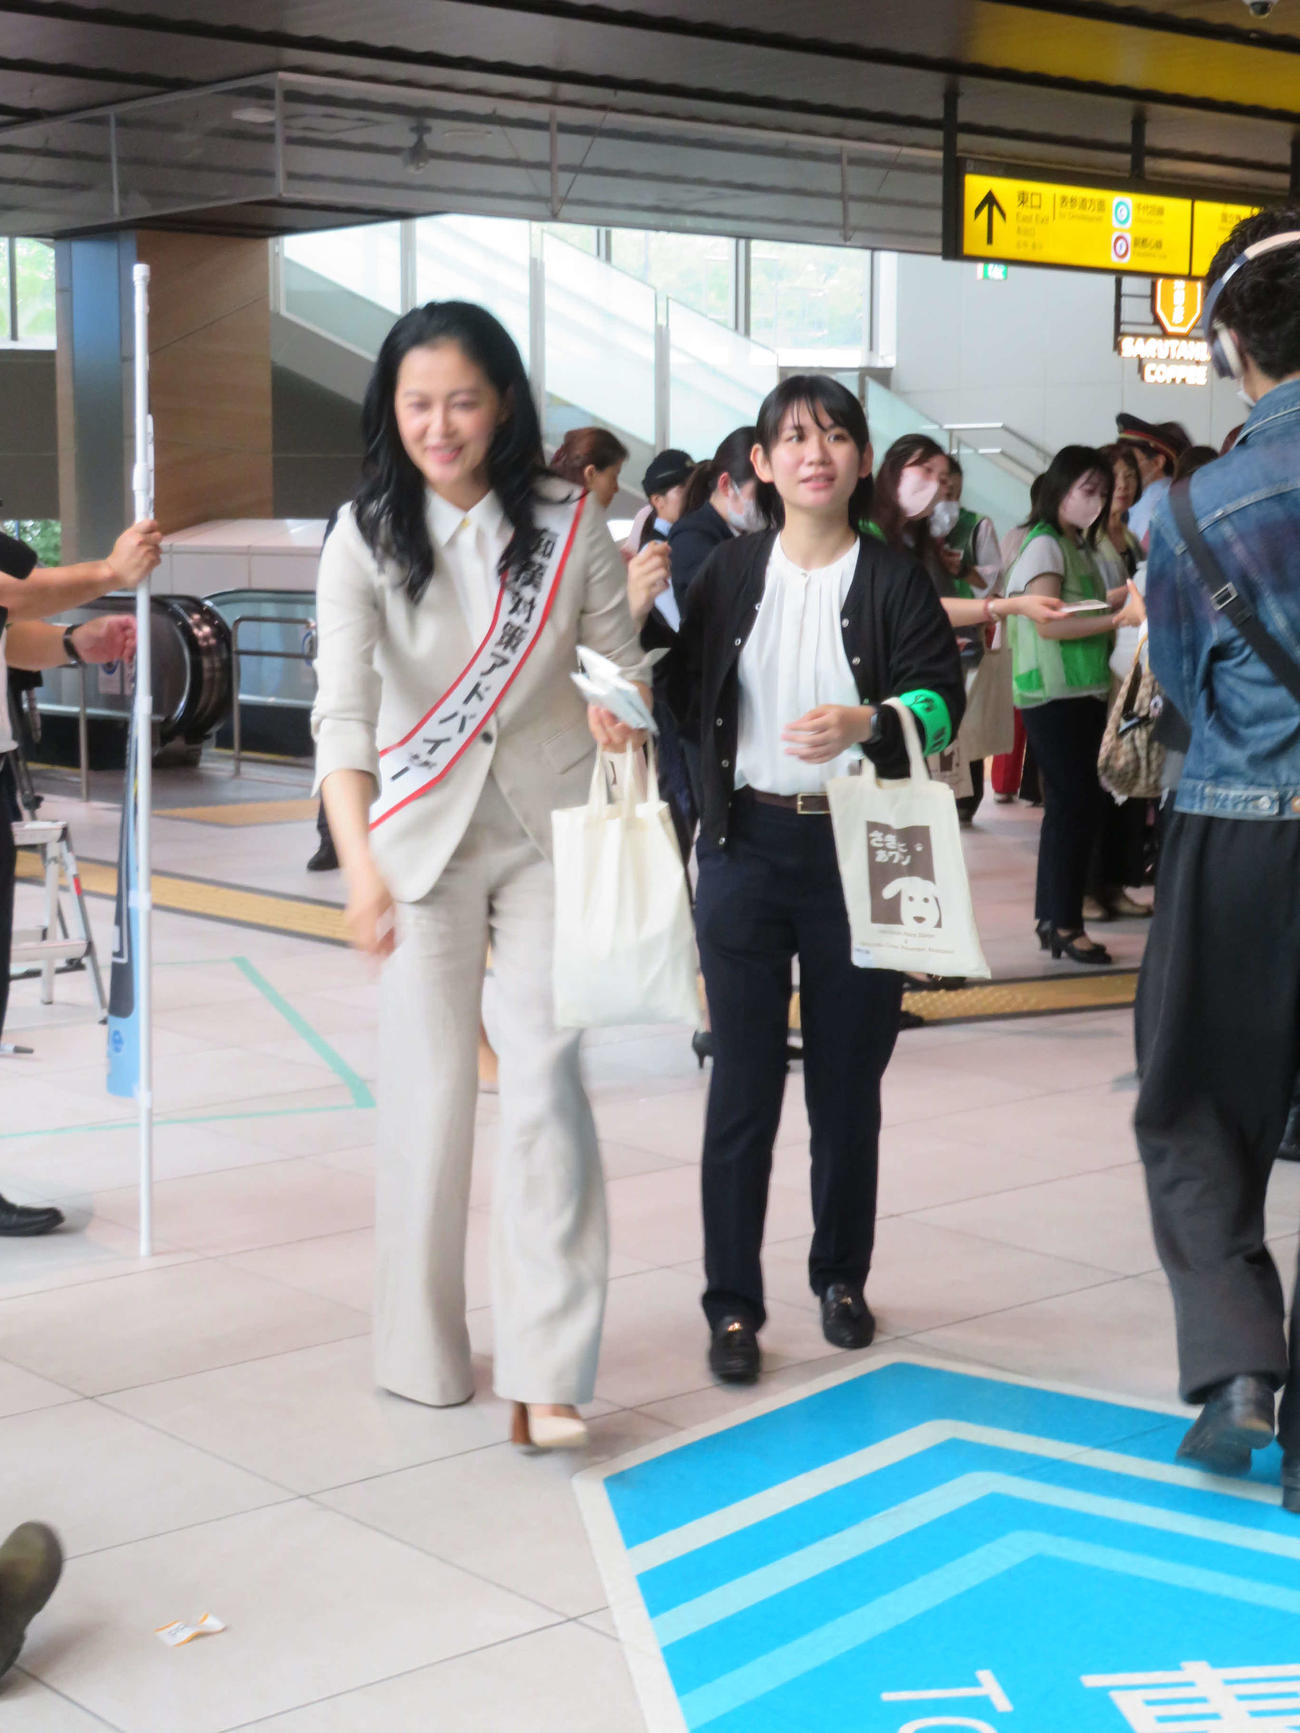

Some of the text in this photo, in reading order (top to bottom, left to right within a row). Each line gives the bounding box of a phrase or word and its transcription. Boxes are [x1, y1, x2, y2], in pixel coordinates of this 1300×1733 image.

[1017, 190, 1042, 209] 東口
[1120, 336, 1210, 361] SARUTAHI
[1144, 363, 1207, 385] COFFEE
